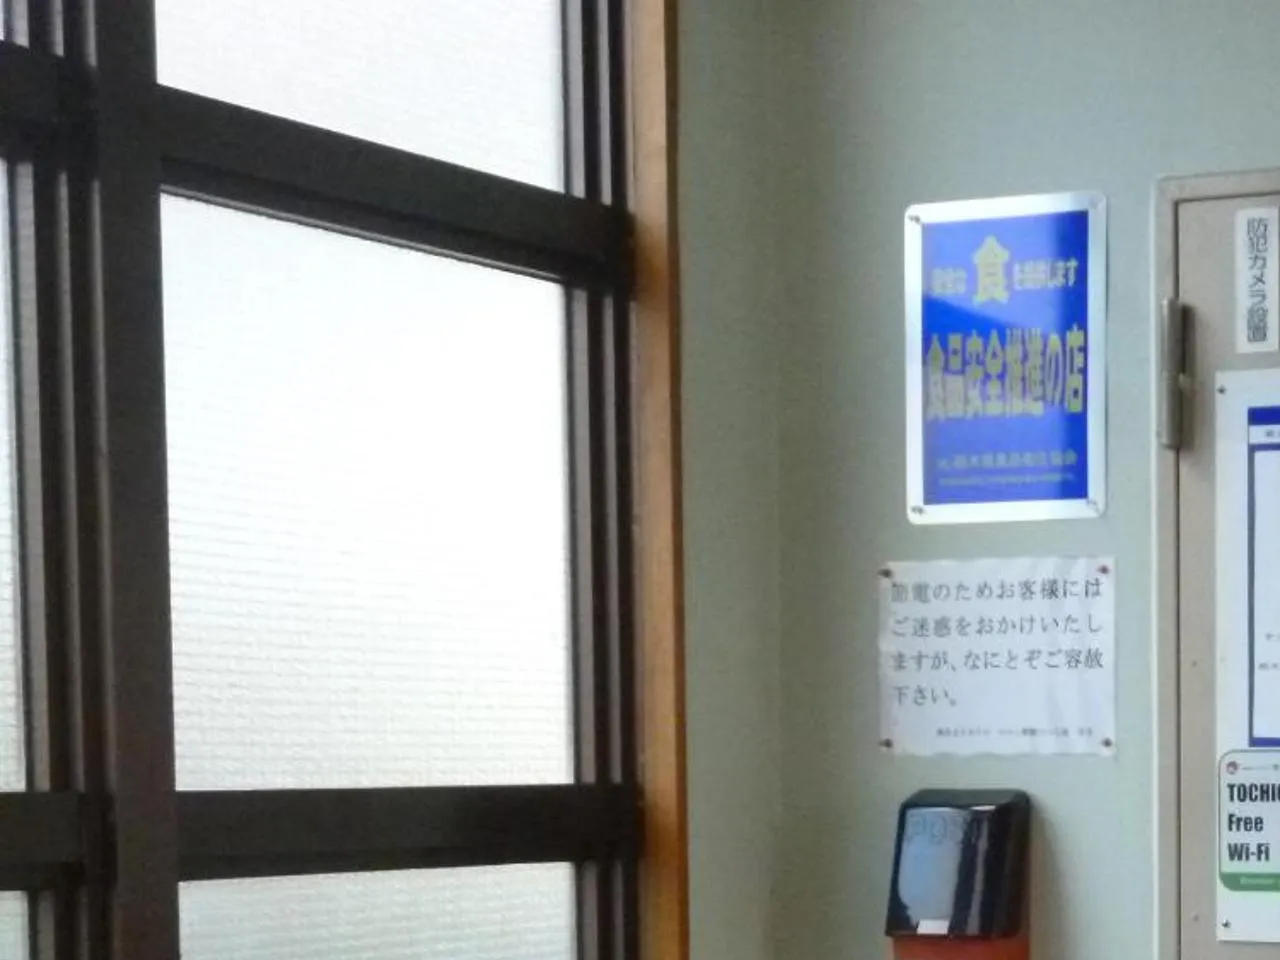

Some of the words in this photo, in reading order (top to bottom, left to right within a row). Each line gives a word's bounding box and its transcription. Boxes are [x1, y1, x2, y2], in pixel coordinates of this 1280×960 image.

[892, 614, 1103, 638] ご迷惑をおかけいたし
[893, 684, 957, 706] 下さい。
[1228, 813, 1264, 832] Free
[1227, 843, 1270, 862] Wi-Fi
